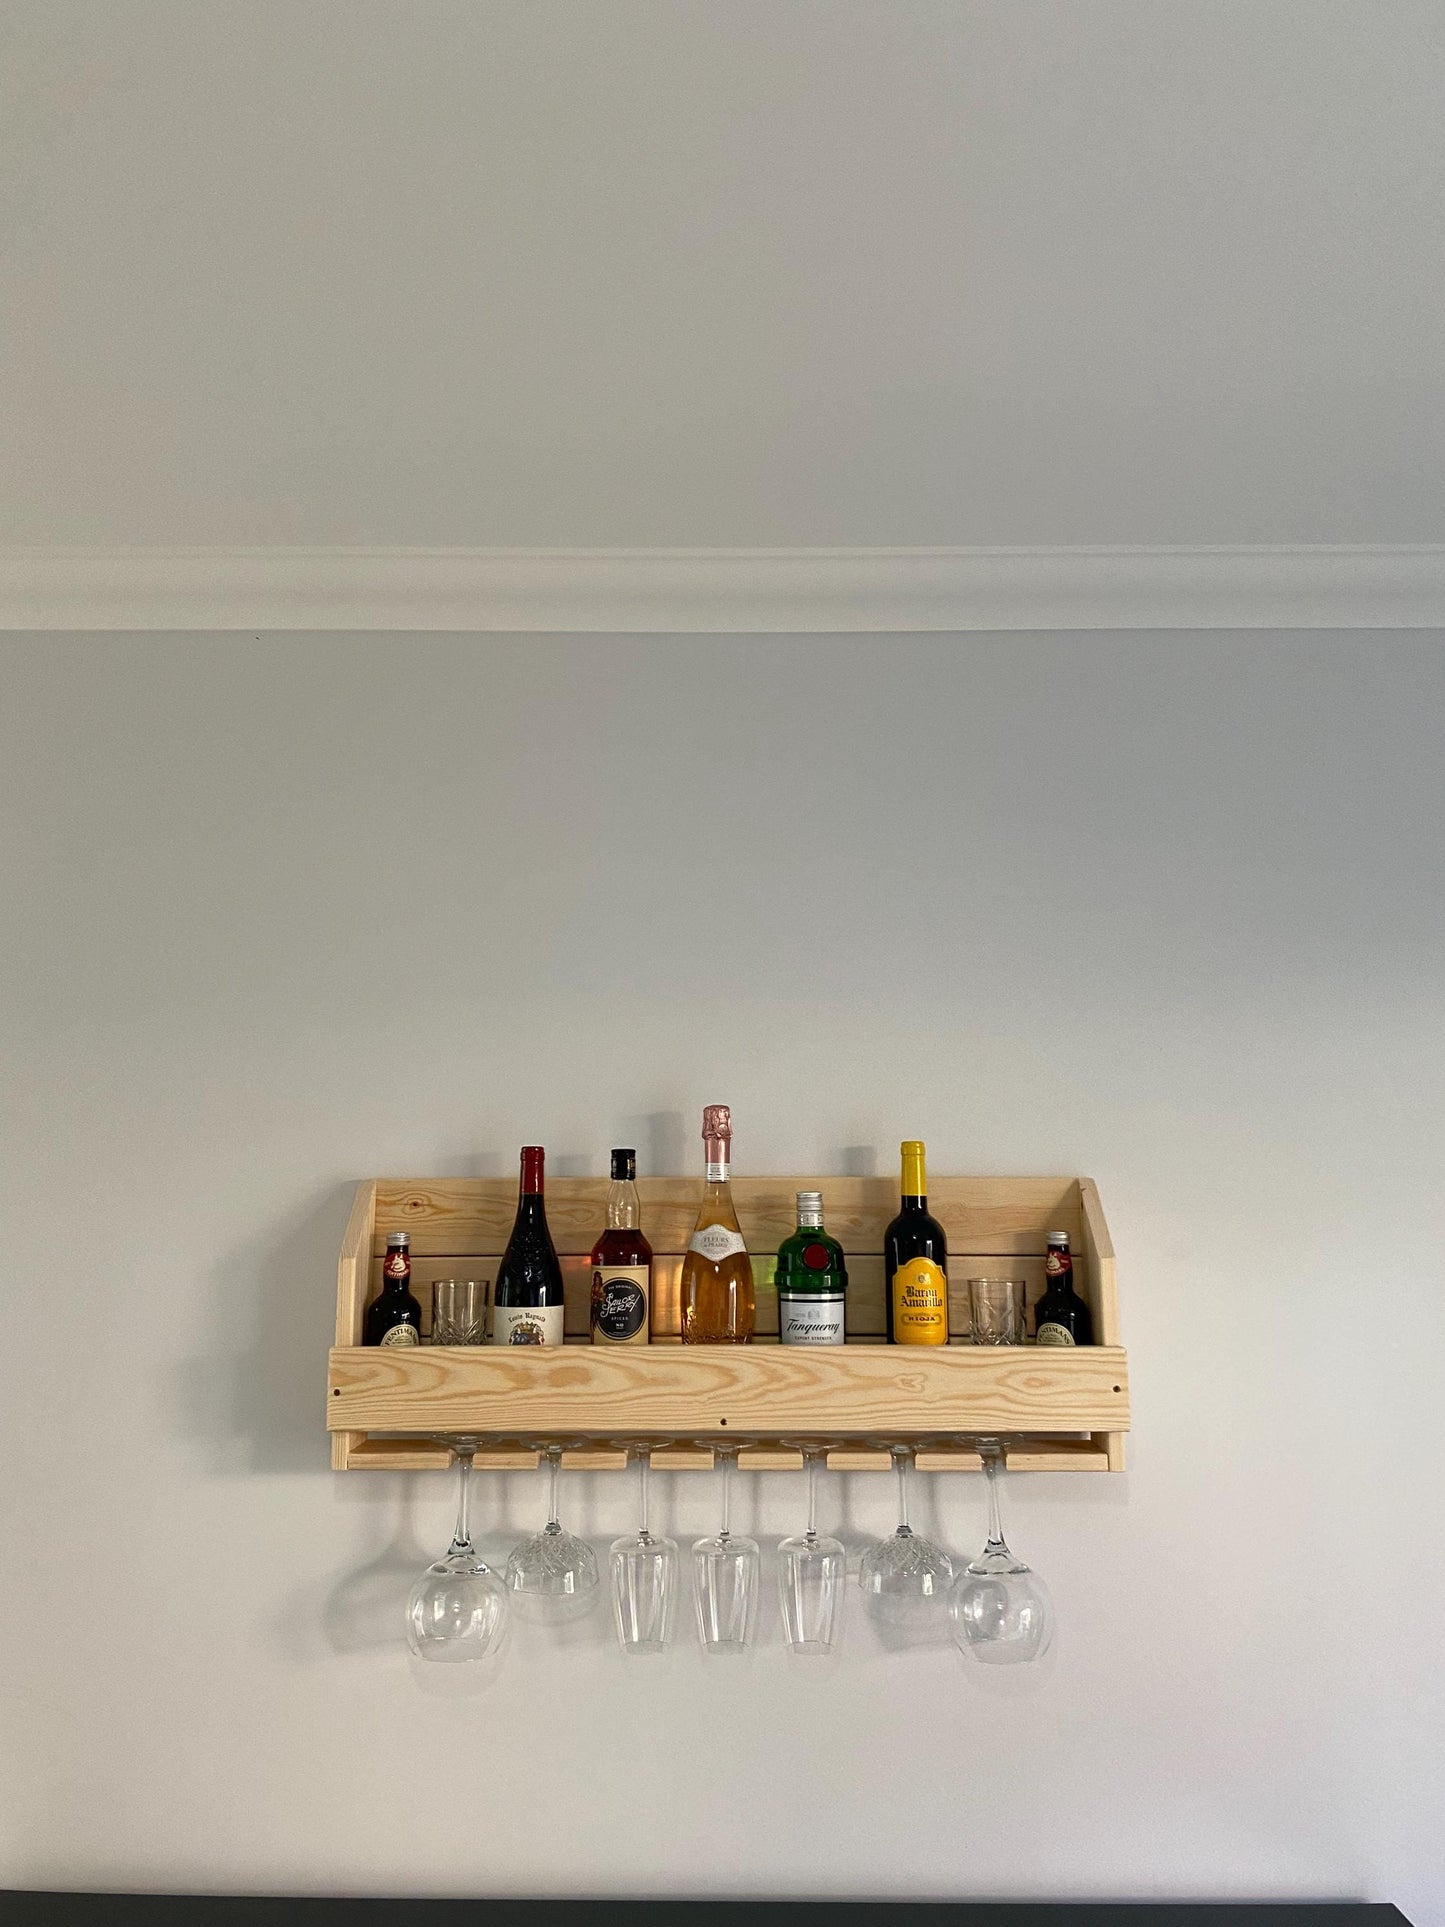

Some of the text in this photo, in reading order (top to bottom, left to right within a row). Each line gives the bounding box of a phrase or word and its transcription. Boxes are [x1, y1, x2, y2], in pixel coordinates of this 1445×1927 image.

[905, 1285, 938, 1298] Baron
[900, 1295, 943, 1308] Amarillo
[786, 1318, 840, 1335] Tanqueray
